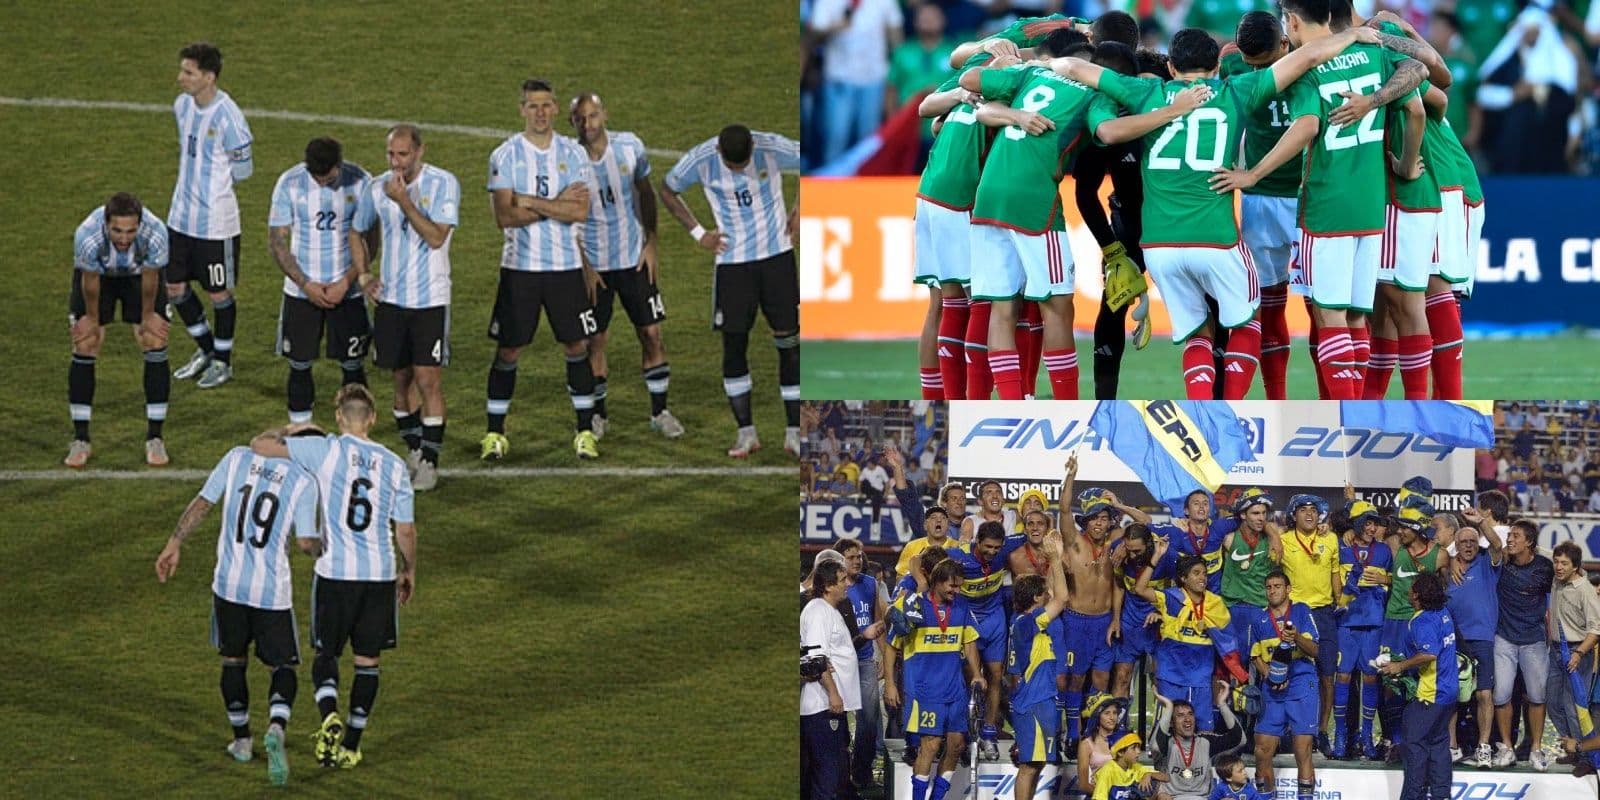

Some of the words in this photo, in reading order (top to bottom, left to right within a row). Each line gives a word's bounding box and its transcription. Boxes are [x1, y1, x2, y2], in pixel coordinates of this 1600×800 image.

[1327, 51, 1369, 71] LOZANO
[1318, 72, 1384, 151] 22
[1147, 107, 1228, 171] 20
[535, 175, 549, 197] 15
[315, 211, 337, 231] 22
[1476, 238, 1541, 282] LA
[1561, 238, 1600, 282] C
[207, 263, 225, 286] 10
[648, 294, 666, 320] 14
[579, 309, 598, 335] 15
[431, 338, 442, 362] 4
[958, 418, 1103, 451] FINA
[1277, 426, 1454, 462] 2004
[1007, 482, 1065, 501] SPORT
[1431, 493, 1471, 511] ORTS
[346, 477, 374, 532] 6
[236, 483, 280, 549] 19
[919, 710, 937, 728] 23
[1046, 736, 1054, 754] 7
[1170, 765, 1204, 778] PESI
[963, 774, 1088, 796] FIAL
[1452, 781, 1532, 800] 004
